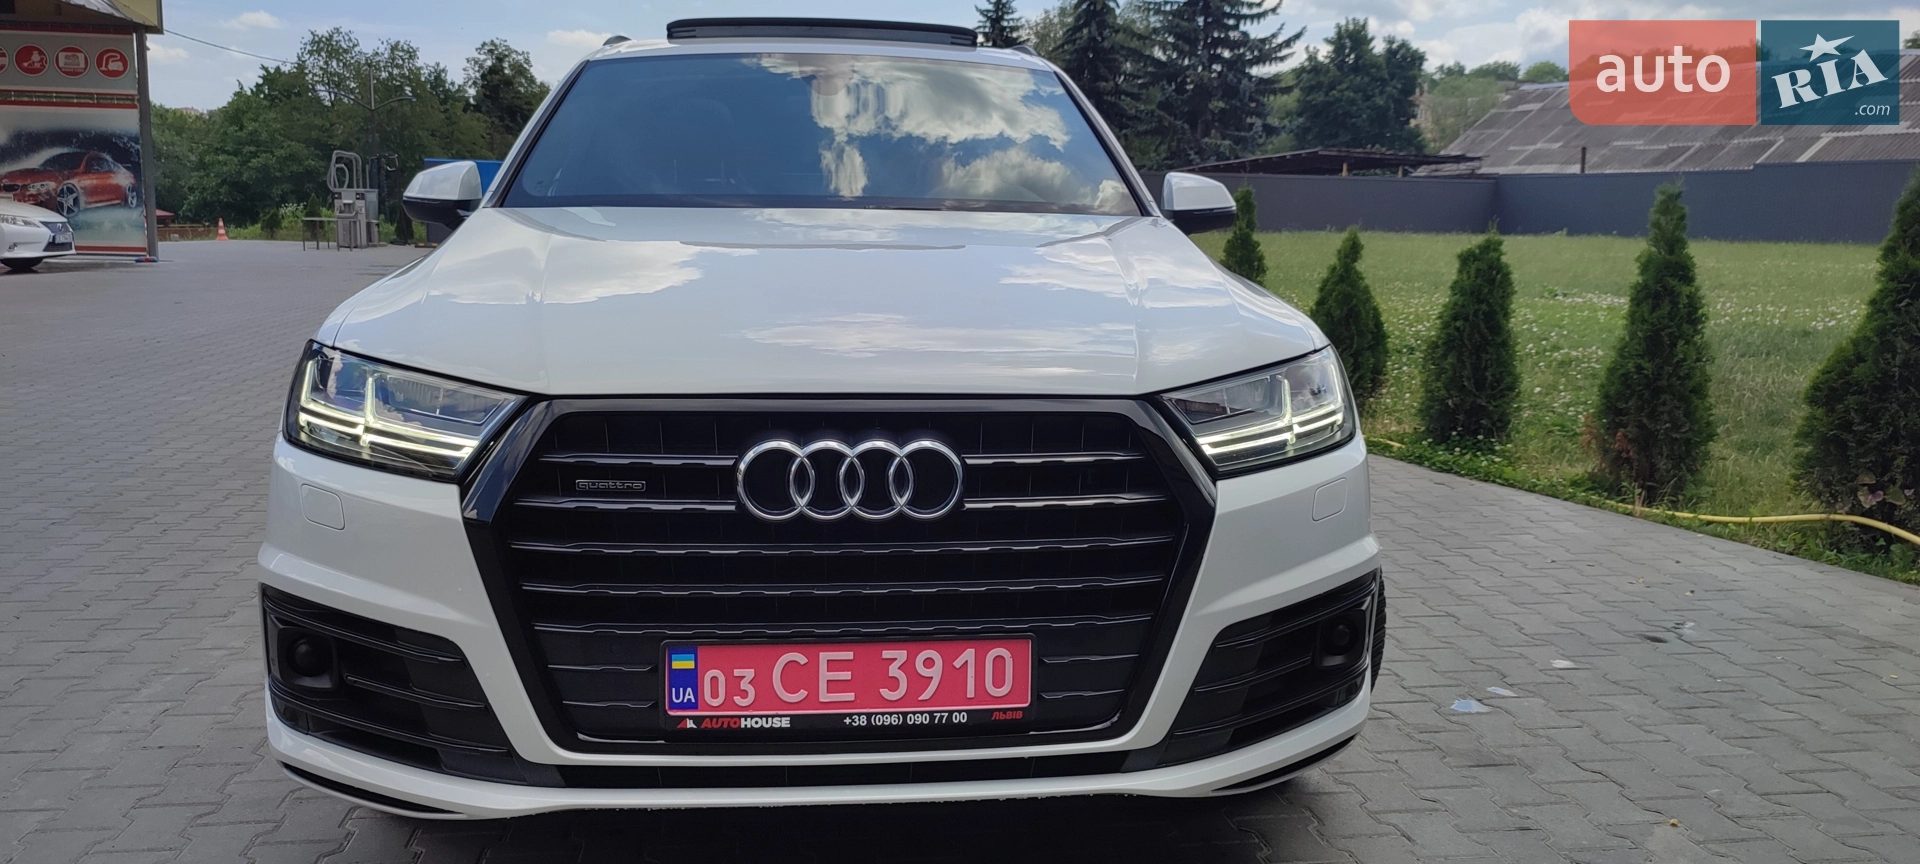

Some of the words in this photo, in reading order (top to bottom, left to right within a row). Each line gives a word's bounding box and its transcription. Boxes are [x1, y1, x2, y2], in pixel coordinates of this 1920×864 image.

[578, 481, 643, 490] quattro
[671, 687, 695, 703] UA
[703, 668, 756, 707] 03
[772, 651, 856, 703] CE
[879, 647, 1014, 702] 3910
[843, 715, 867, 726] +38
[871, 713, 903, 726] (096)
[906, 713, 930, 724] 090
[933, 712, 949, 723] 77
[952, 712, 968, 723] 00
[991, 710, 1023, 720] ЛЬВІВ
[700, 717, 791, 729] AUTOHOUSE
